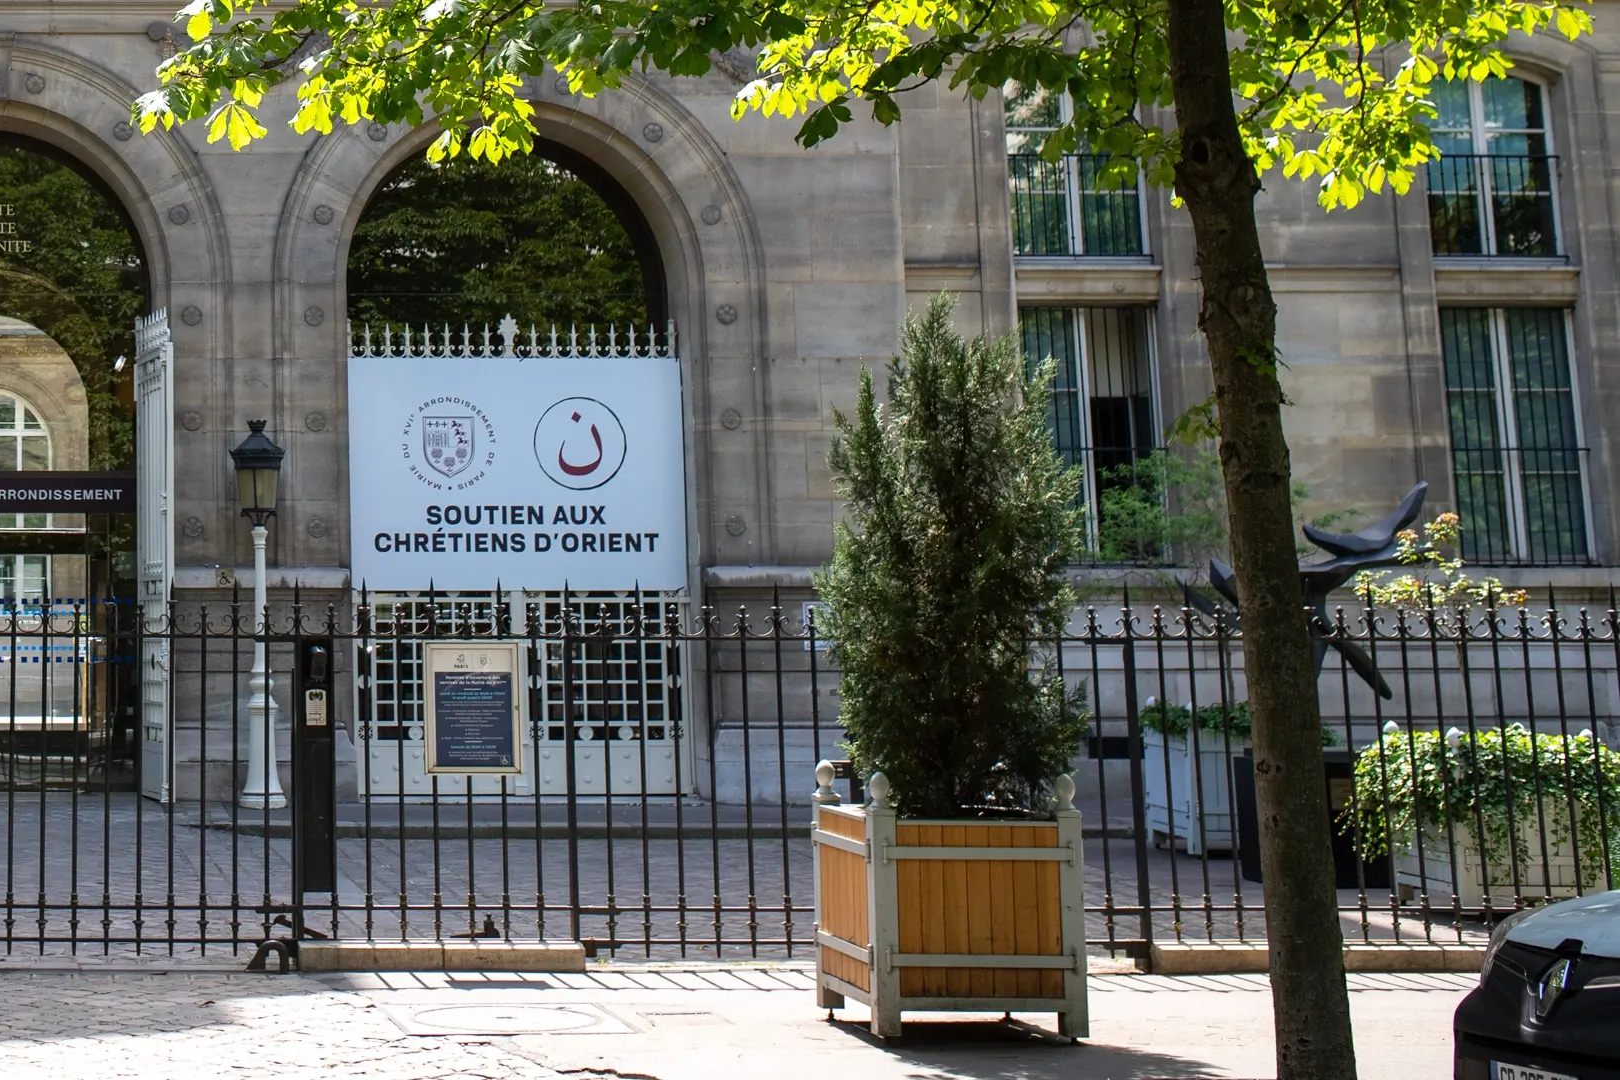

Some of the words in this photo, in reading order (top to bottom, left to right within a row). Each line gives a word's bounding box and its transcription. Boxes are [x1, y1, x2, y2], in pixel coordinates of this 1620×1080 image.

[418, 396, 496, 444] ARRONDISSEMENT
[402, 444, 410, 459] DU
[485, 452, 495, 466] DE
[409, 465, 442, 490] MAIRIE
[457, 470, 485, 490] PARIS
[426, 505, 545, 525] SOUTIEN
[552, 505, 607, 525] AUX
[374, 527, 526, 553] CHRÉTIENS
[534, 532, 659, 553] D'ORIENT
